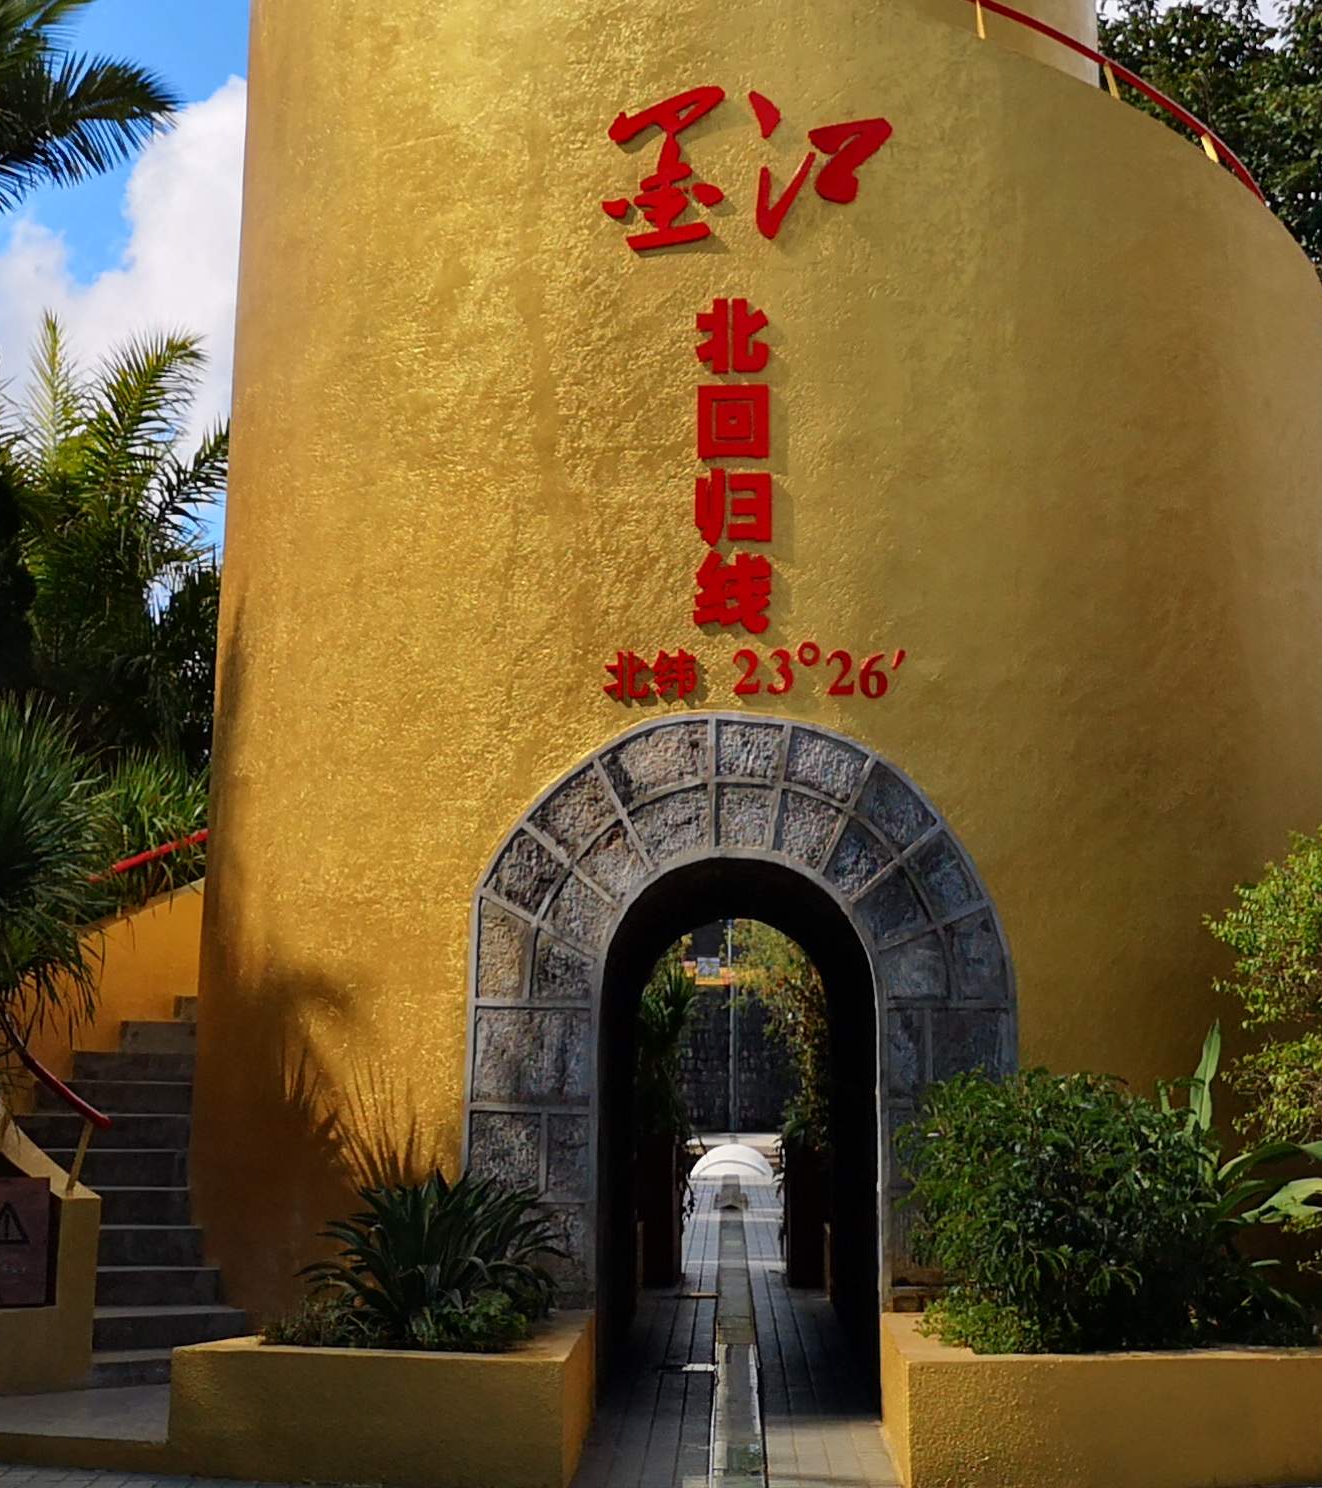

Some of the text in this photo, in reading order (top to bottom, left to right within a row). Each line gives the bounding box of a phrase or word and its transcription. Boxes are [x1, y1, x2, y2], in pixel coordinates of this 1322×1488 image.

[602, 85, 893, 252] 墨江
[693, 298, 773, 635] 北回归线
[603, 649, 698, 701] 北纬
